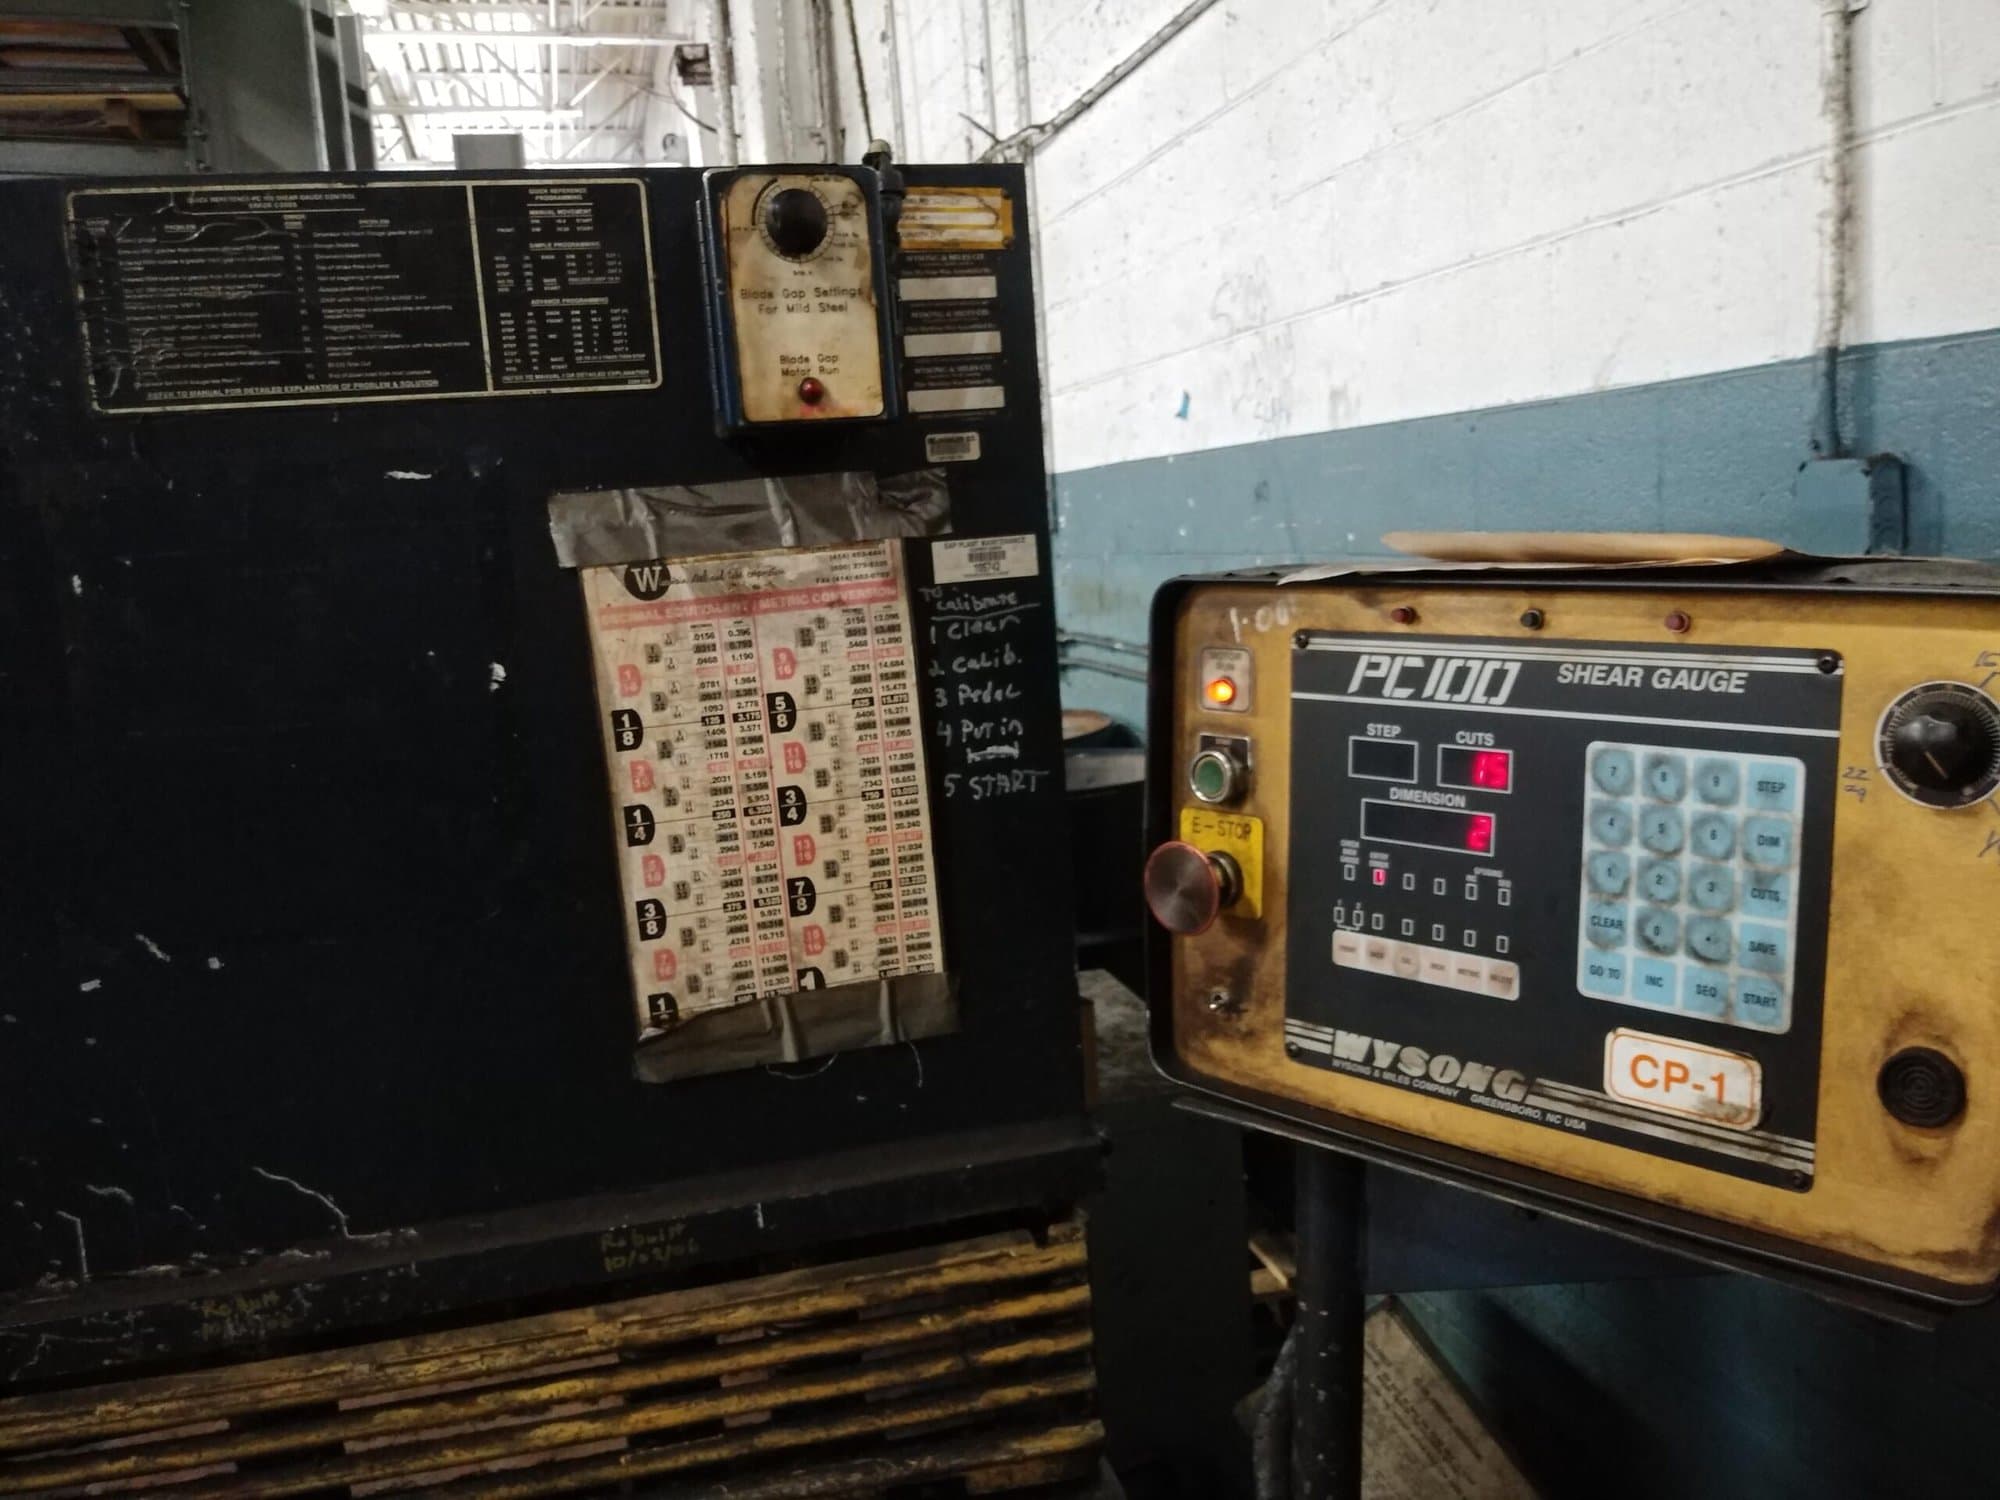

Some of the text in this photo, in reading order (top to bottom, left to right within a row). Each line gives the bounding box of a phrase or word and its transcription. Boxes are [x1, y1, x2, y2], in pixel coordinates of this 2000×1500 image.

[740, 284, 862, 301] Blade Gap Settings
[758, 300, 849, 315] For Mild Steel
[780, 352, 839, 366] Blade Gap
[781, 365, 840, 378] Motor Run
[930, 625, 937, 645] 1
[1557, 663, 1749, 694] SHEAR GAUGE
[774, 696, 787, 712] 5
[934, 687, 948, 707] 3
[620, 712, 632, 729] 1
[777, 711, 789, 729] 8
[935, 719, 952, 747] 4
[1365, 722, 1402, 739] STEP
[1455, 730, 1496, 747] CUTS
[621, 730, 635, 748] 8
[1608, 765, 1617, 777] 7
[943, 769, 1051, 800] 5 START
[1757, 780, 1786, 793] STEP
[784, 789, 797, 805] 3
[1388, 786, 1467, 808] DIMENSION
[632, 809, 643, 825] 1
[786, 806, 799, 822] 4
[1191, 815, 1252, 841] E-STOP
[1607, 817, 1616, 828] 4
[1657, 822, 1666, 834] 5
[634, 827, 646, 843] 4
[1709, 829, 1718, 841] 6
[1756, 834, 1781, 848] DIM
[1655, 873, 1665, 885] 2
[1707, 880, 1715, 893] 3
[794, 880, 807, 897] 7
[643, 902, 657, 920] 3
[796, 897, 808, 914] 8
[646, 920, 659, 937] 8
[1590, 915, 1624, 930] CLEAR
[1748, 940, 1777, 956] SAVE
[1589, 964, 1621, 980] GO TO
[1644, 974, 1665, 988] INC
[1695, 983, 1718, 998] SEQ
[1742, 992, 1778, 1008] START
[1332, 1028, 1530, 1105] WYSONG
[1629, 1053, 1726, 1105] CP-1
[1411, 1078, 1461, 1098] COMPANY
[1470, 1093, 1544, 1121] GREENSBORO,
[1545, 1112, 1563, 1125] NC
[1563, 1115, 1588, 1132] USA
